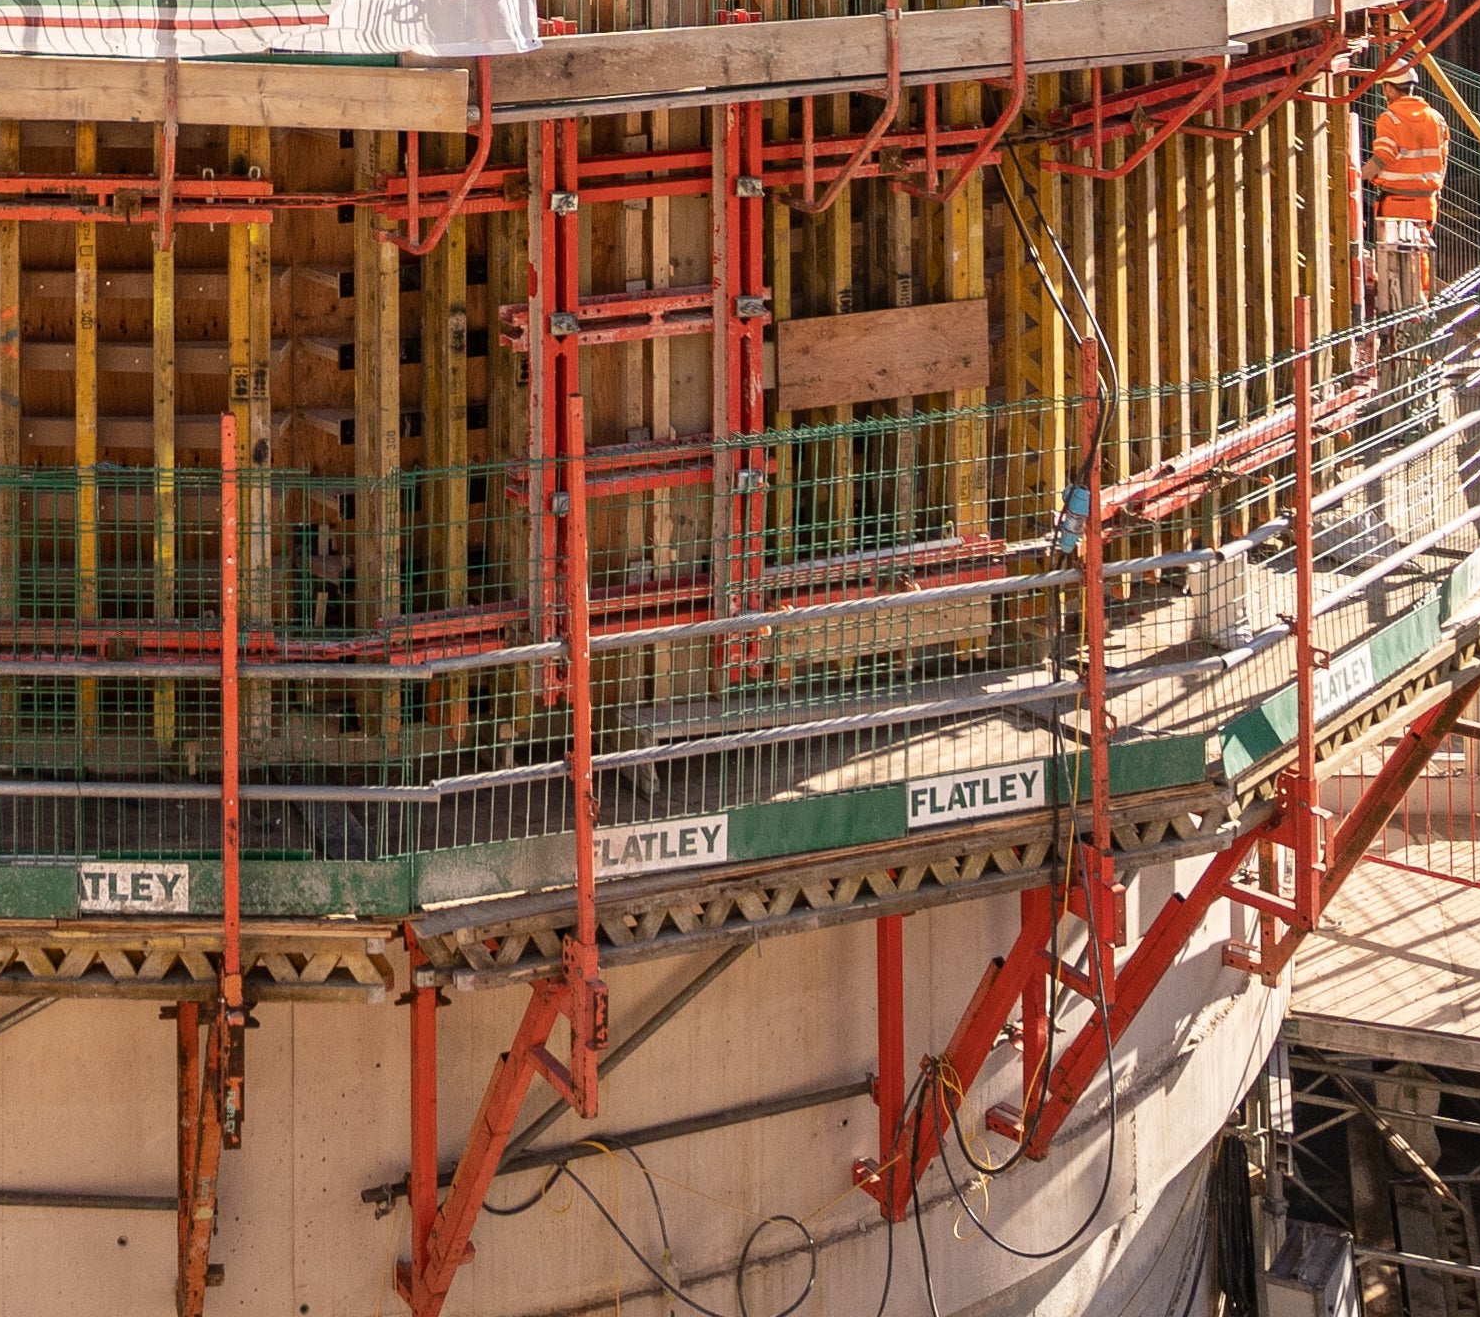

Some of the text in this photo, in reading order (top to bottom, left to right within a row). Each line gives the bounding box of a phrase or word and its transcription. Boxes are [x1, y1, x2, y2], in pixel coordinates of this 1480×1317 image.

[80, 309, 93, 331] 300
[385, 429, 397, 451] 300
[911, 769, 1039, 817] FLATLEY
[82, 872, 182, 903] TLEY
